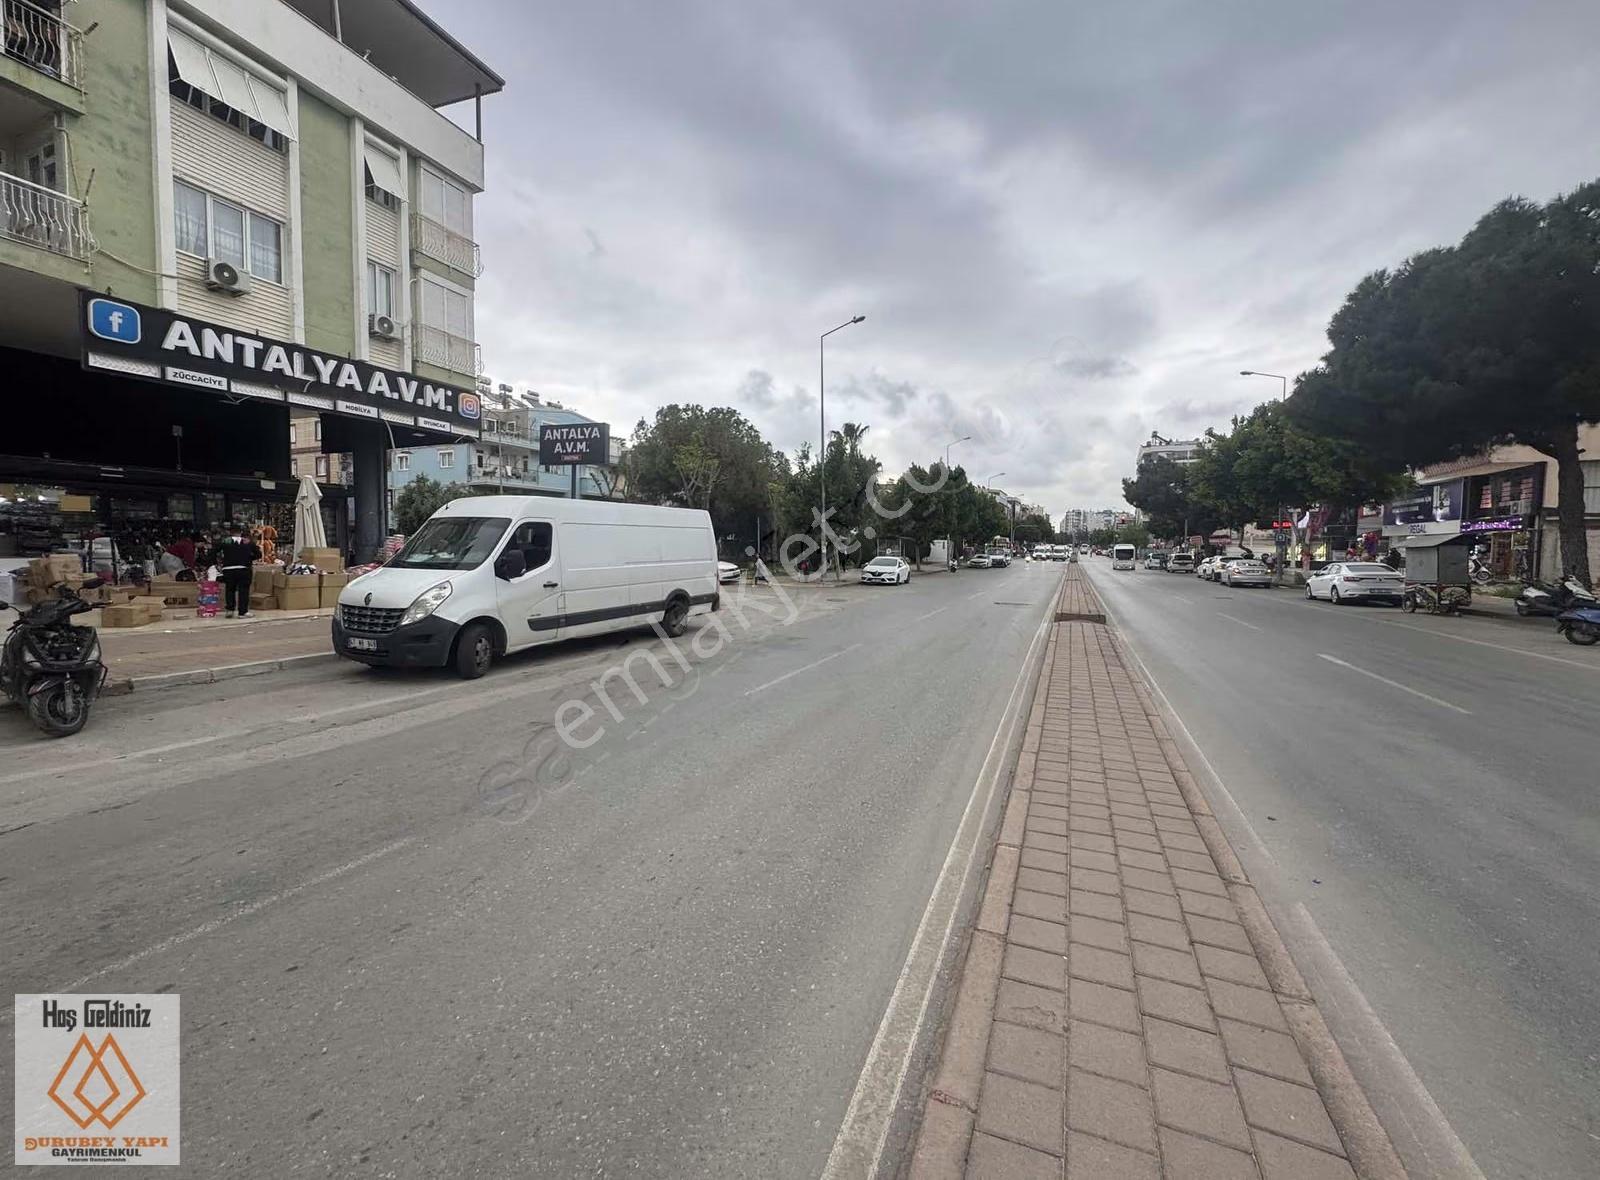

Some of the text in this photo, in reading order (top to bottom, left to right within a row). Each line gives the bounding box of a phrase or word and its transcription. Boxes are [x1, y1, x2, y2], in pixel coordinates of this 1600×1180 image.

[161, 320, 363, 392] ANTALYA
[172, 371, 224, 387] ZÜCCACİYE
[544, 427, 601, 441] ANTALYA
[554, 441, 590, 454] A.V.M.
